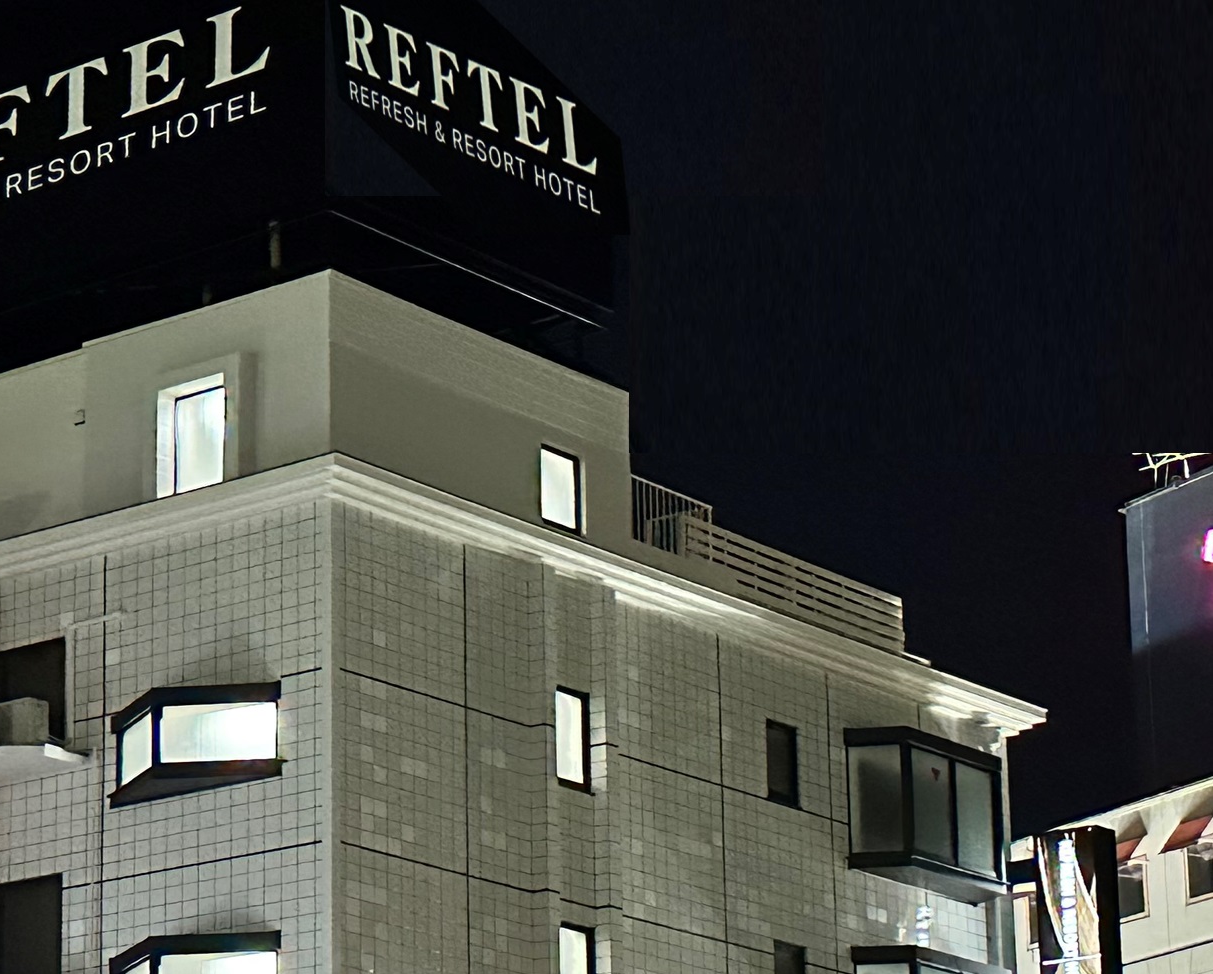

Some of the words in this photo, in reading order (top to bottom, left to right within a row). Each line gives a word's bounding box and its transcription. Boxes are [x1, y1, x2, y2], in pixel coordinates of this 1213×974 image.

[5, 134, 138, 200] RESORT
[150, 90, 268, 150] HOTEL
[340, 5, 599, 176] REFTEL
[348, 81, 429, 135] REFRESH
[434, 119, 447, 144] &
[452, 128, 526, 179] RESORT
[534, 164, 602, 215] HOTEL
